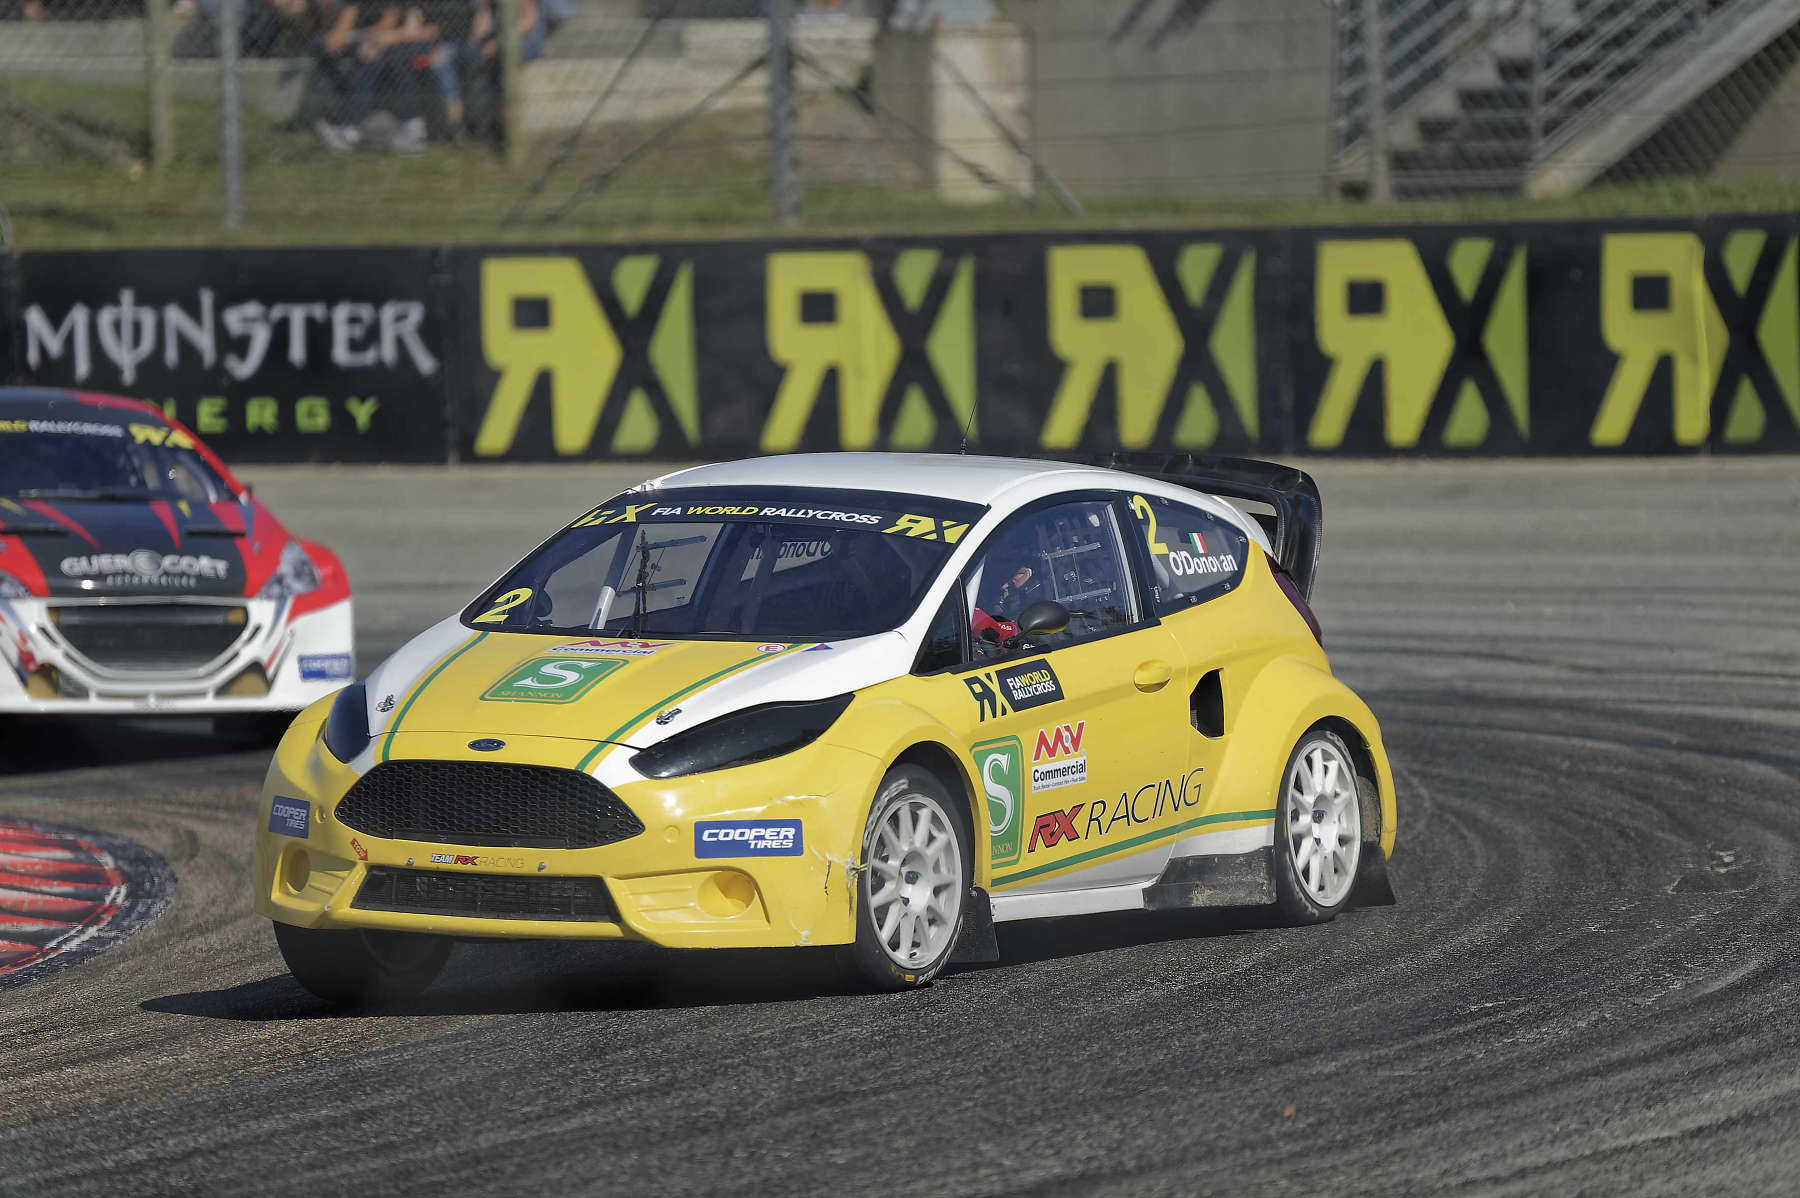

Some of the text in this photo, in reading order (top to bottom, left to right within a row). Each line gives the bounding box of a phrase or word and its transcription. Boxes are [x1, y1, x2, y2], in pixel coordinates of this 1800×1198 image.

[24, 287, 440, 387] MONSTER
[759, 248, 979, 454] RX
[1040, 243, 1259, 449] RX
[1307, 237, 1530, 448] RX
[474, 254, 700, 457] RX
[650, 505, 883, 525] FIA WORLD RALLYCROSS
[880, 513, 971, 544] RX
[1132, 494, 1169, 555] 2
[1168, 550, 1239, 577] O'Donovan
[471, 587, 533, 624] 2
[552, 646, 656, 656] Commercial
[512, 660, 603, 690] S
[1006, 669, 1051, 691] FIA WORLD
[963, 670, 1014, 723] RX
[1011, 680, 1057, 701] RALLYCROSS
[1032, 759, 1087, 783] Commercial
[982, 752, 1015, 837] S
[272, 804, 308, 821] COOPER
[286, 818, 306, 831] TIRES
[1027, 767, 1205, 854] RX RACING
[702, 827, 796, 842] COOPER
[747, 839, 794, 849] TIRES
[430, 853, 455, 865] TEAM
[453, 854, 480, 866] RX
